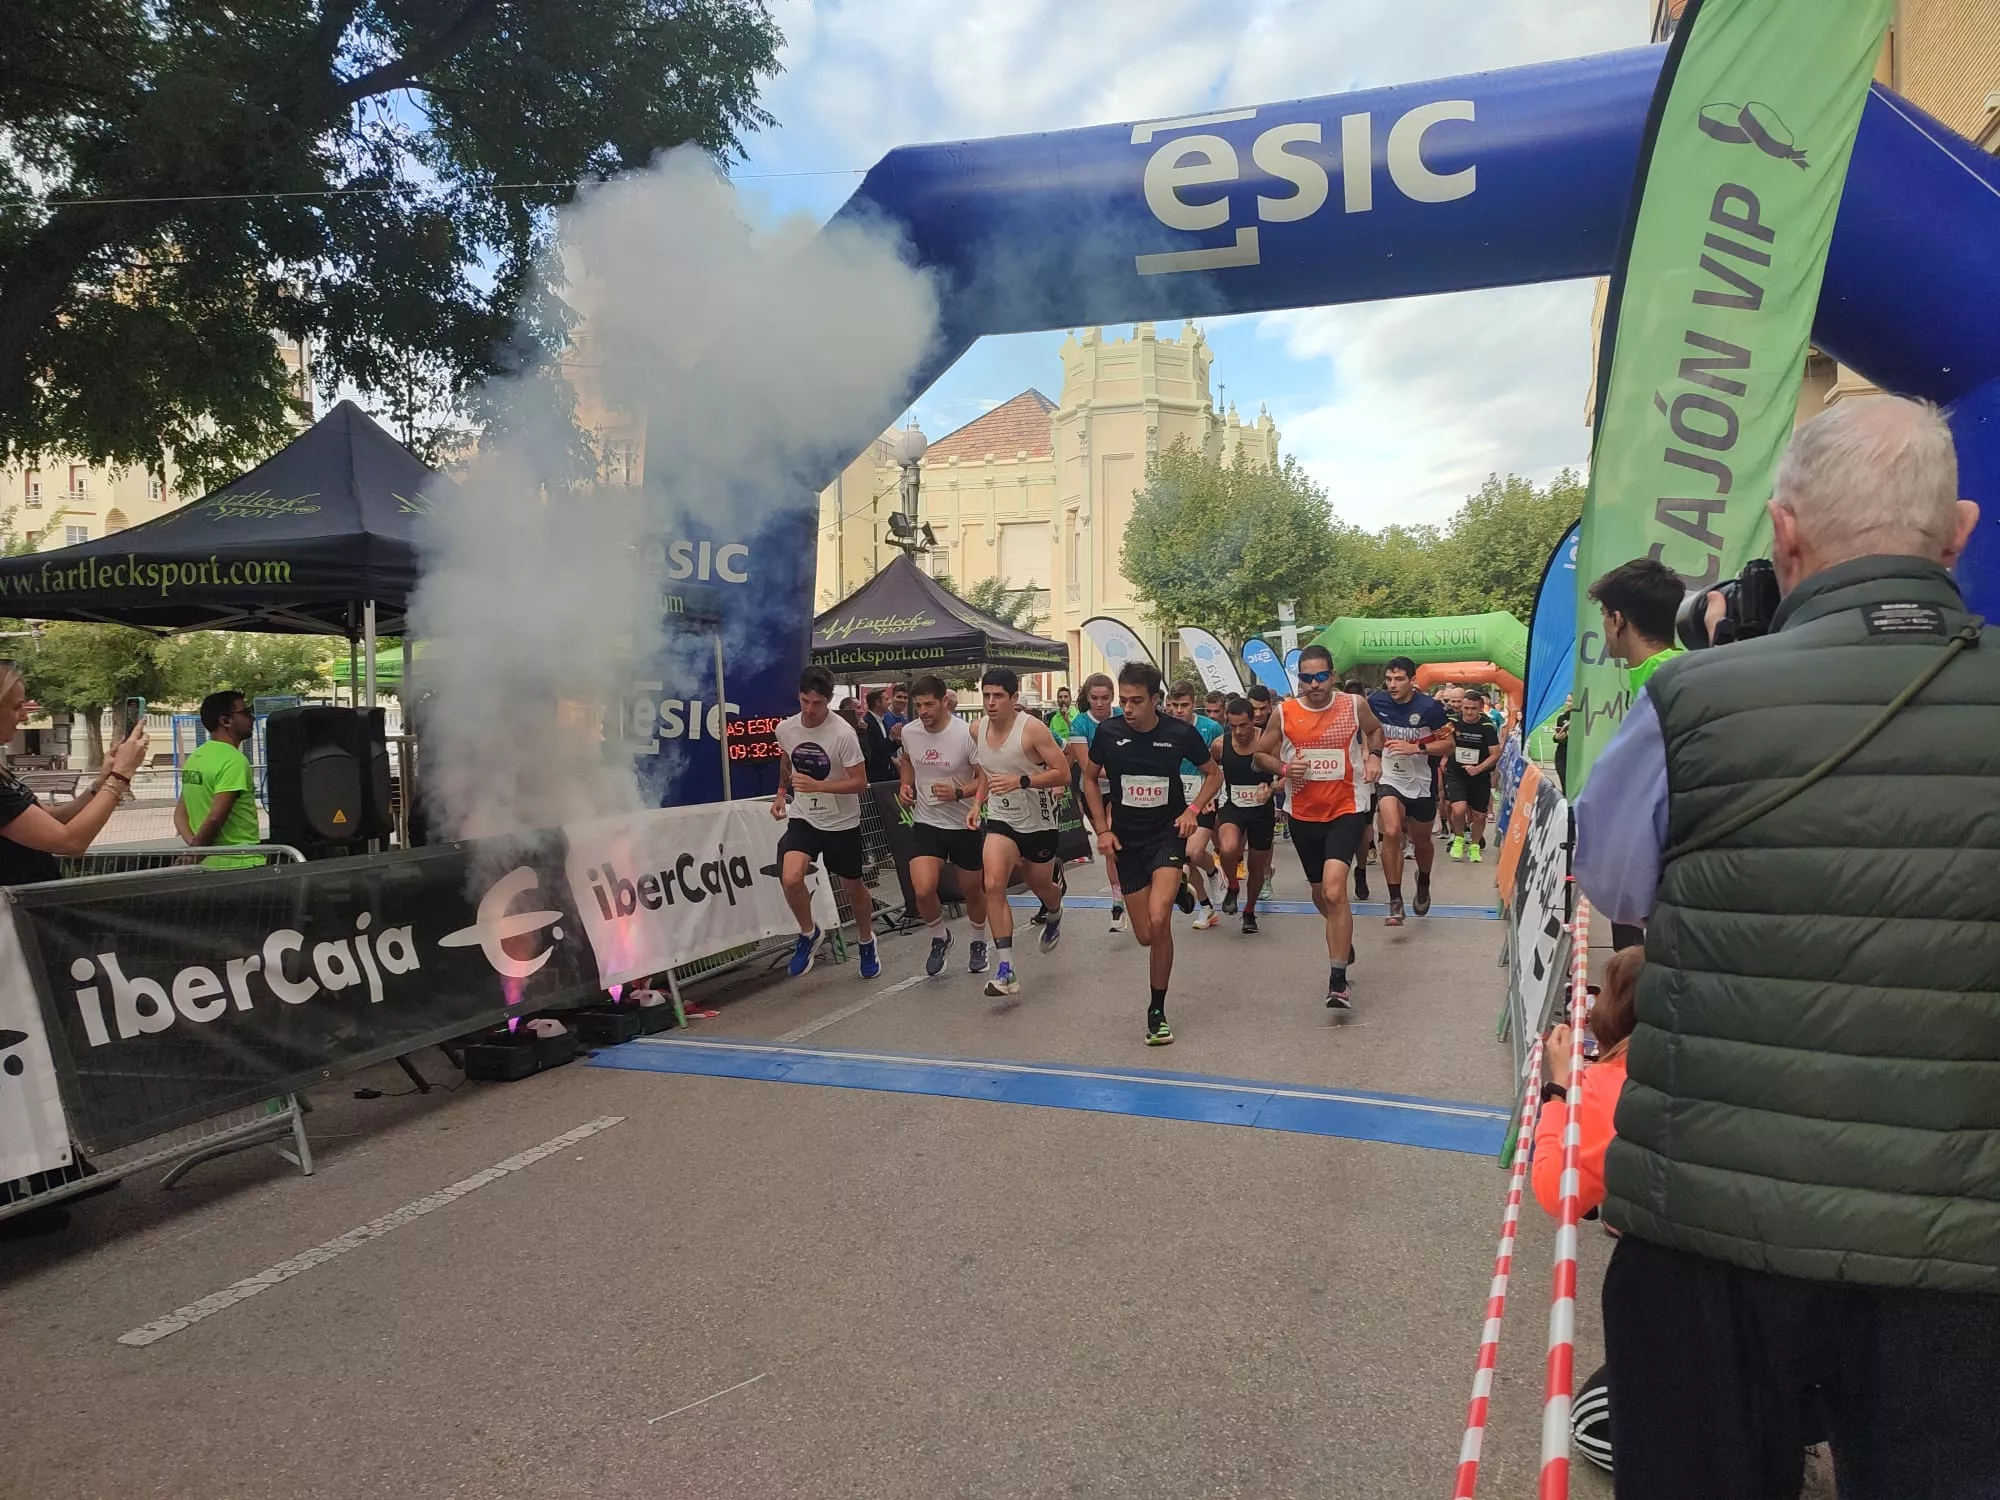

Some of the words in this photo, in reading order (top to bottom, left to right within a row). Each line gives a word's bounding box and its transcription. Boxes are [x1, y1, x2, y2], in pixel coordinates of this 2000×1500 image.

[1691, 181, 1776, 311] VIP
[1362, 629, 1431, 647] FARTLECK
[1435, 627, 1479, 646] SPORT
[1383, 724, 1421, 741] MBEROS
[730, 741, 783, 760] 09:32:3
[1307, 759, 1338, 770] 1200
[1127, 786, 1162, 796] 1016
[1236, 791, 1256, 799] 101
[810, 798, 818, 807] 7
[1002, 798, 1010, 807] 9
[1038, 788, 1050, 822] ERREX
[587, 843, 753, 921] iberCaja
[70, 912, 421, 1047] iberCaja
